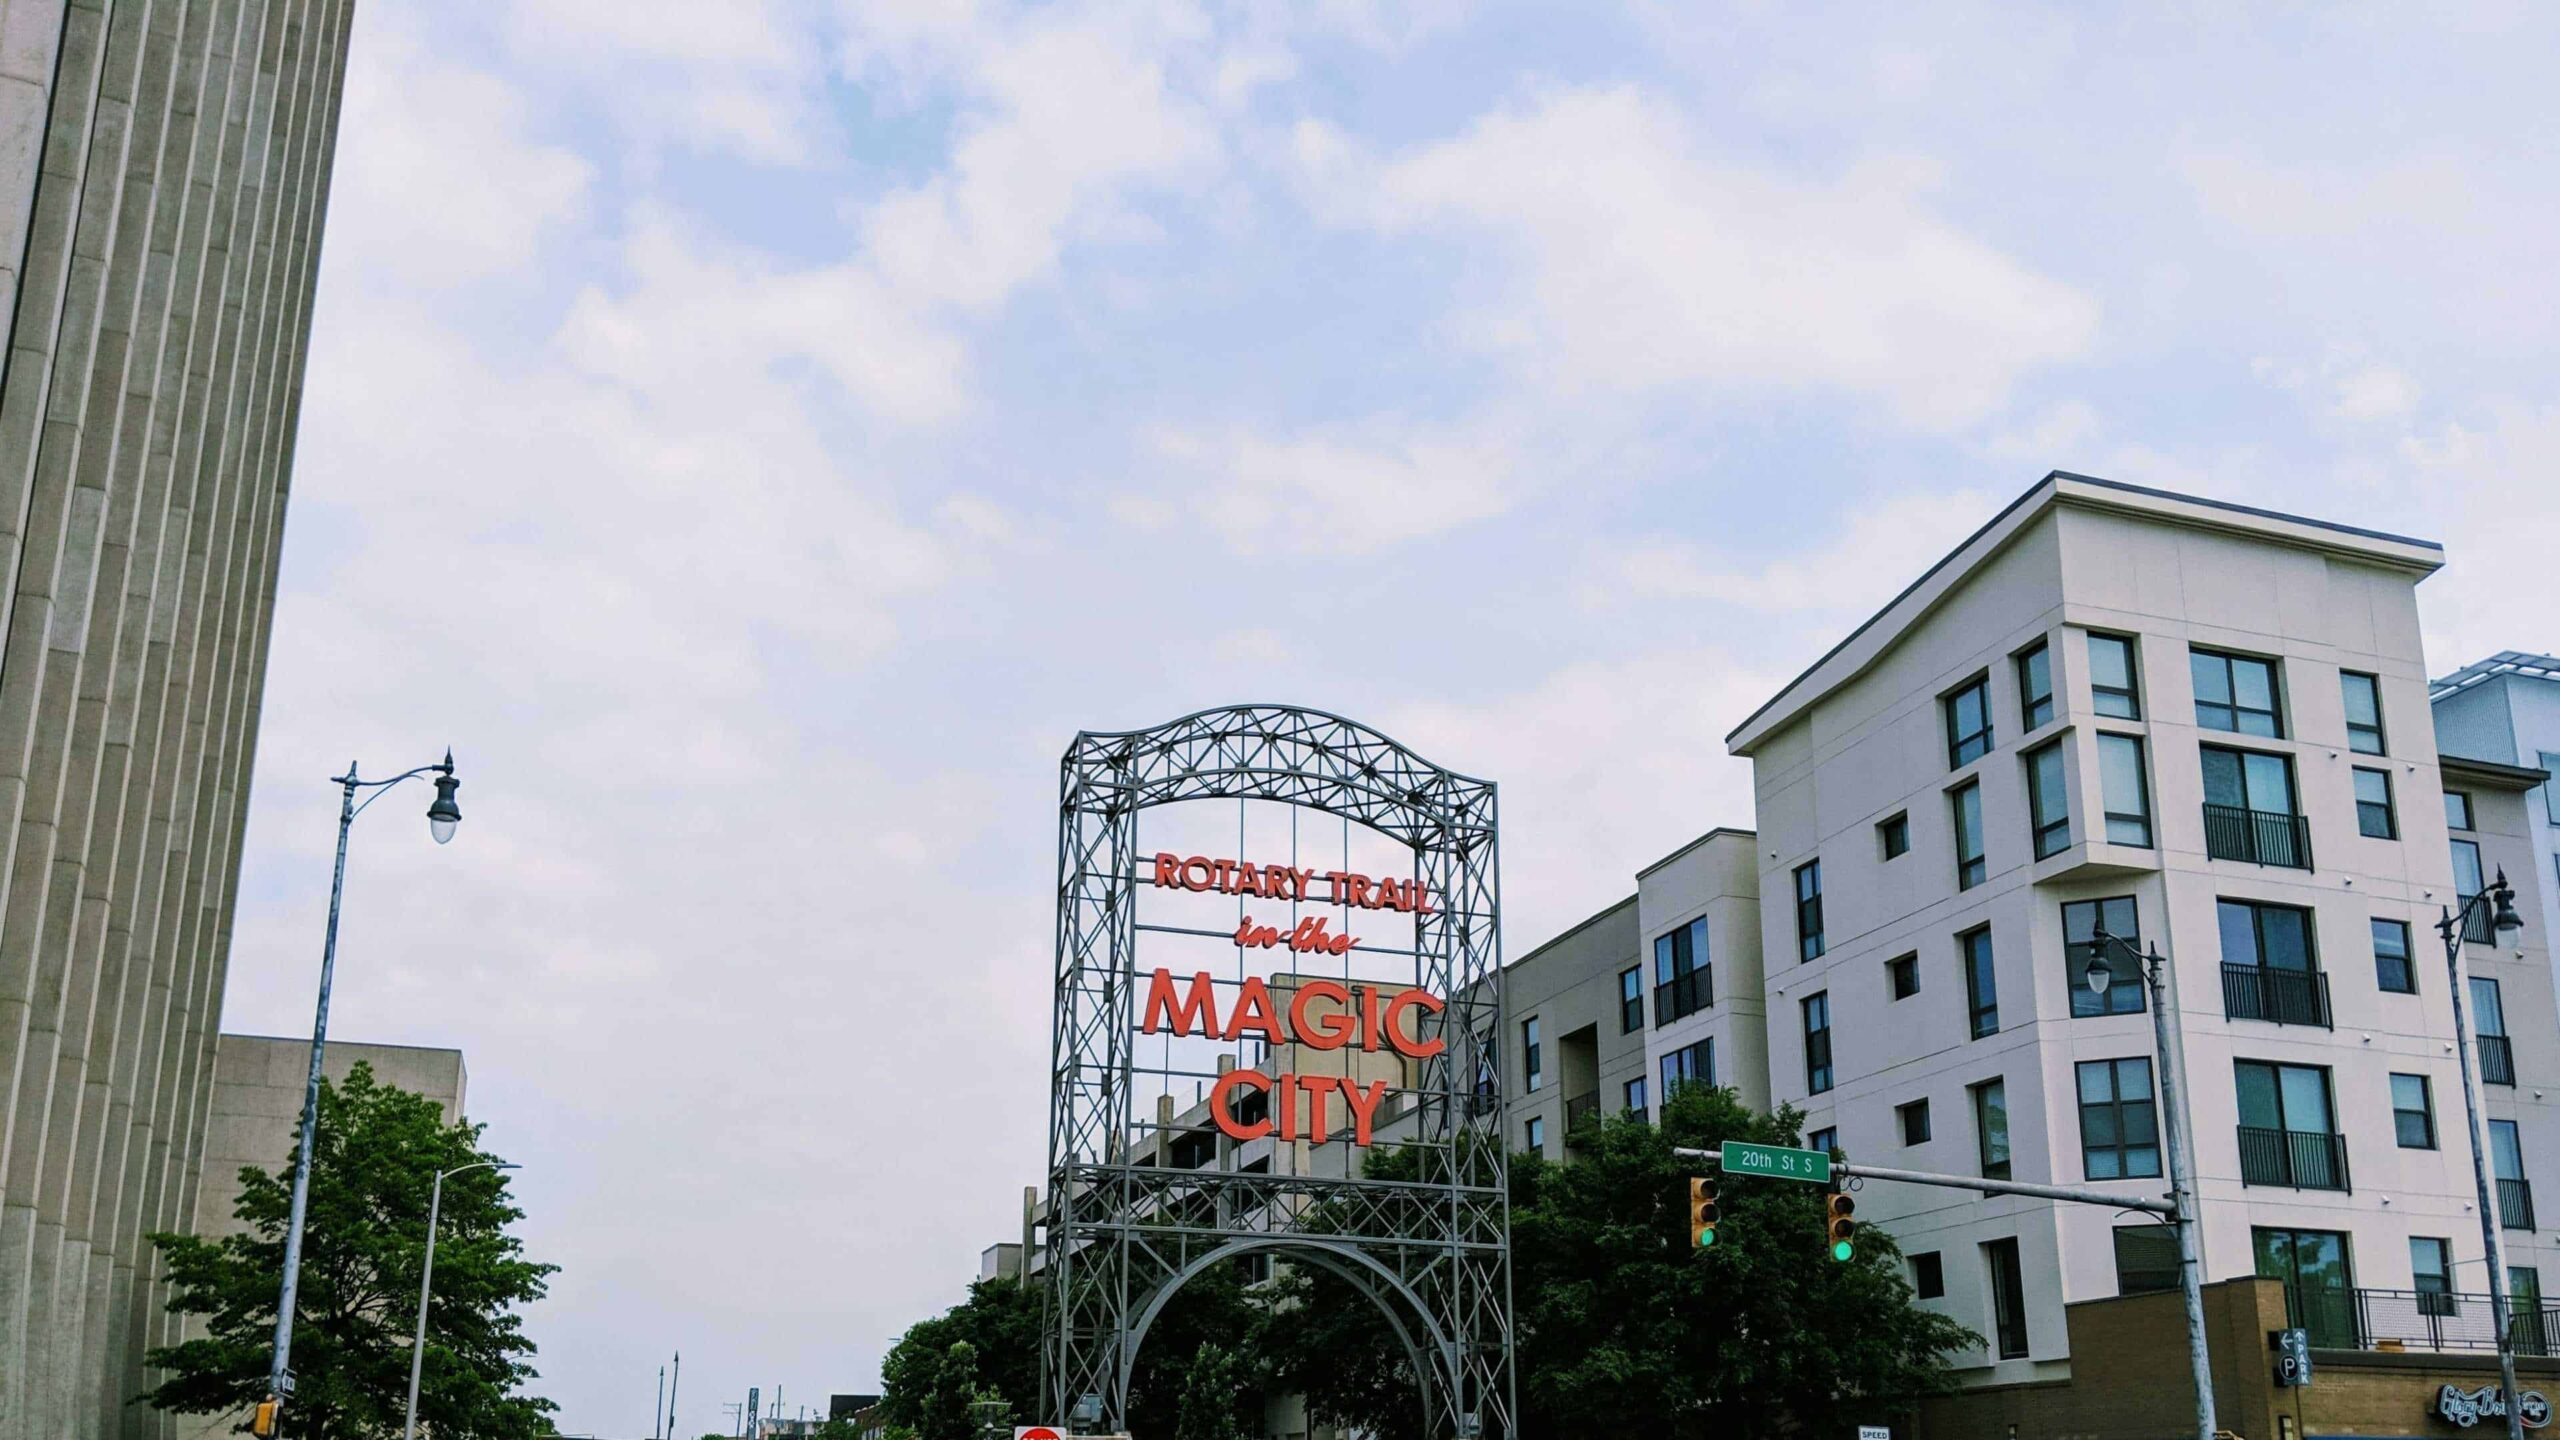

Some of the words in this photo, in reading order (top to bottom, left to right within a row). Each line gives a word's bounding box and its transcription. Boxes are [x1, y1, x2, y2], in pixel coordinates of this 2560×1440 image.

[1155, 853, 1314, 901] ROTARY
[1326, 871, 1434, 914] TRAIL
[1234, 916, 1290, 949] in
[1288, 916, 1361, 955] the
[1142, 968, 1445, 1058] MAGIC
[1210, 1069, 1388, 1147] CITY
[1741, 1150, 1773, 1169] 20th
[1781, 1154, 1796, 1172] St
[1803, 1157, 1813, 1174] S
[2283, 1357, 2296, 1377] P
[2297, 1343, 2309, 1385] PARK
[1861, 1430, 1888, 1440] SPEED
